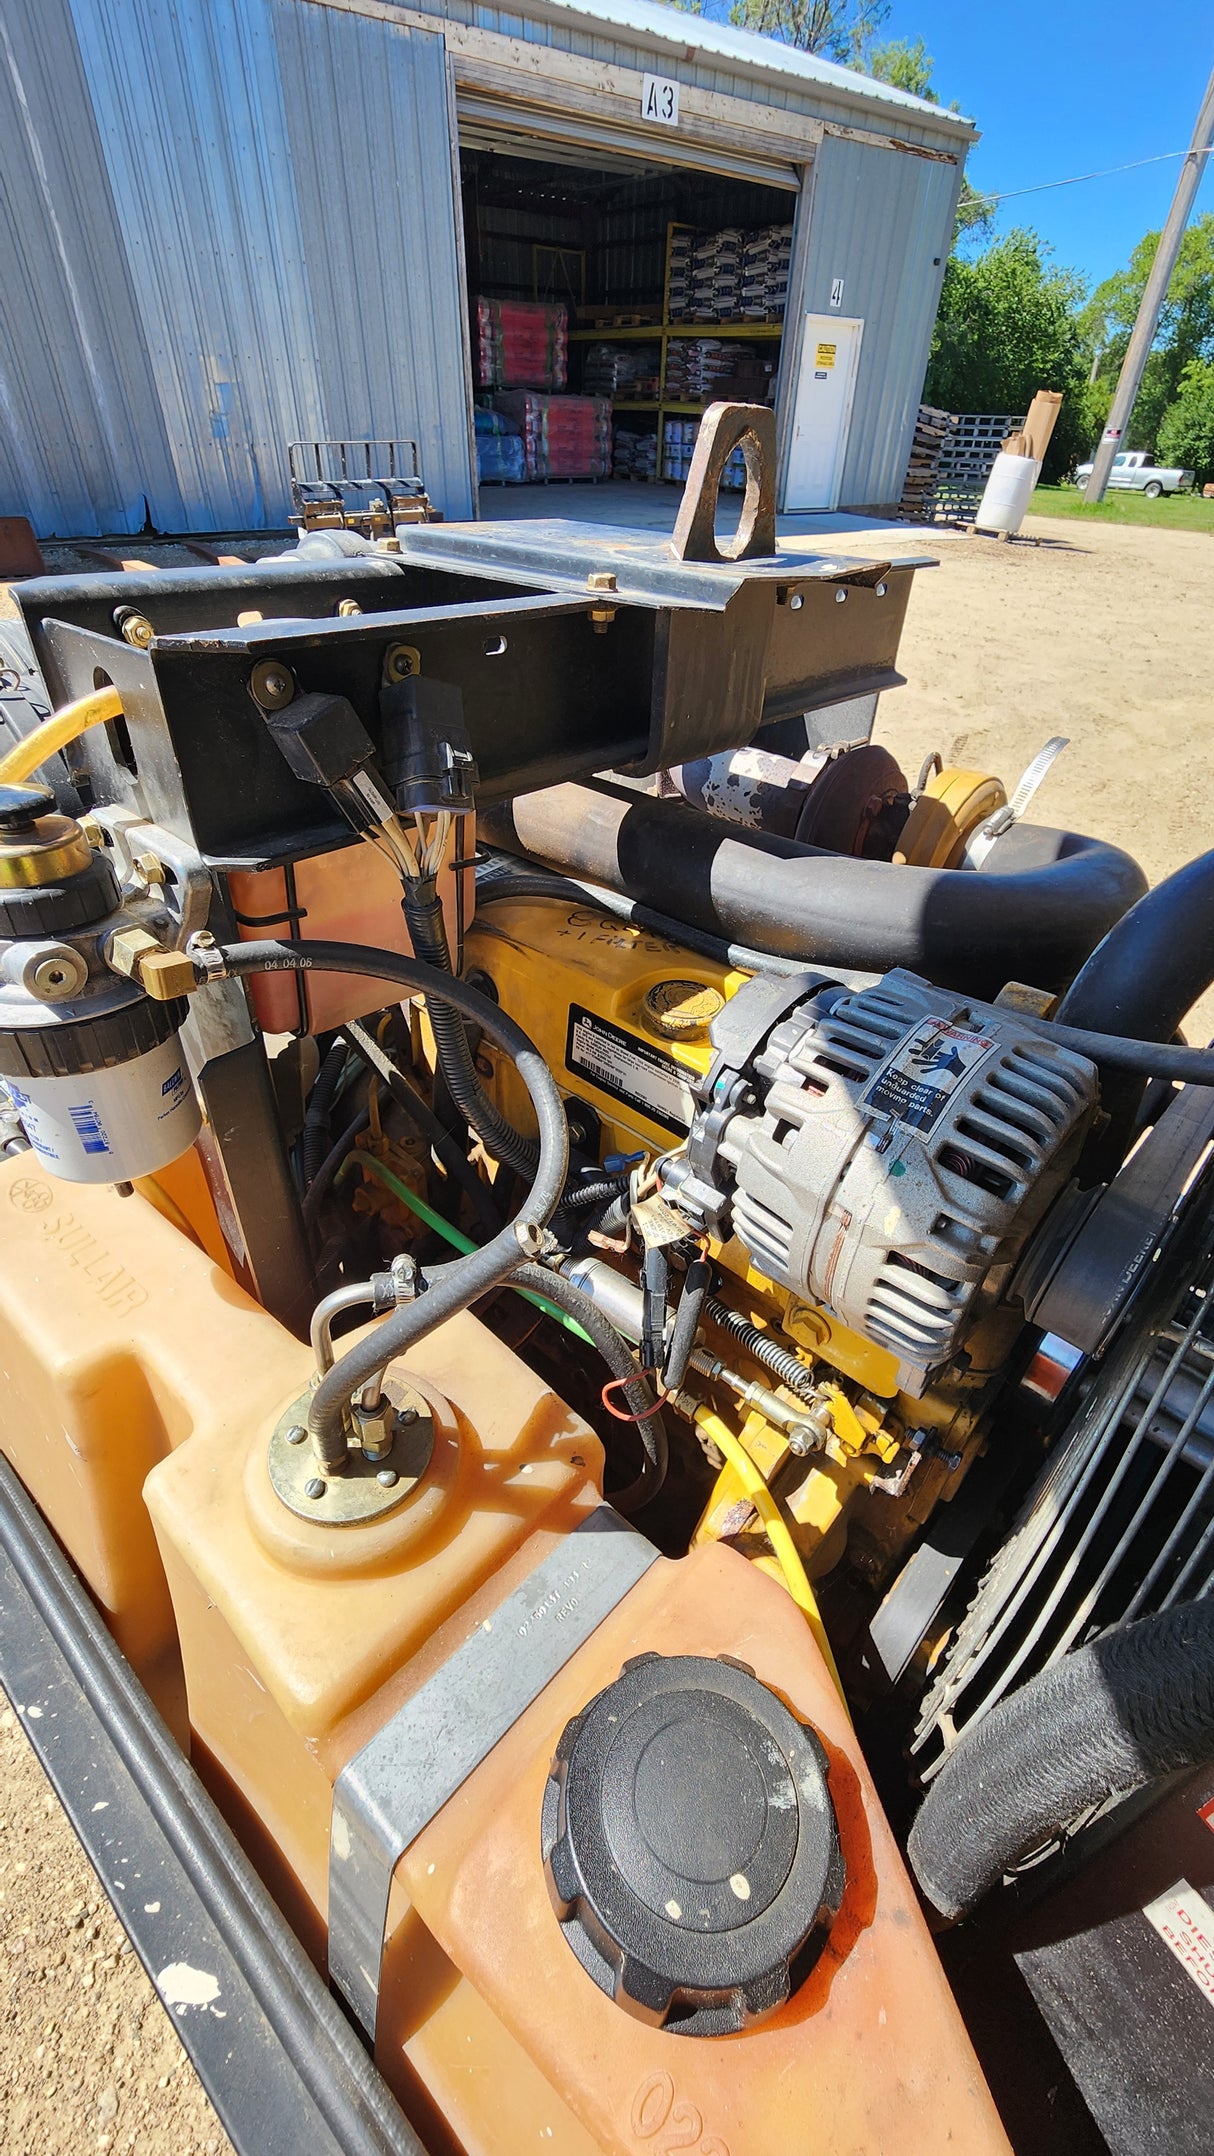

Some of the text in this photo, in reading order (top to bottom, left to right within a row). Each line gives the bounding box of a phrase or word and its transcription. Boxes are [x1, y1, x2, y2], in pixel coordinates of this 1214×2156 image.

[646, 81, 674, 119] A3
[831, 280, 842, 306] 4
[264, 961, 278, 971] 04
[283, 959, 296, 969] 04
[943, 1027, 989, 1049] WARNING
[881, 1077, 927, 1103] unguarded
[885, 1068, 947, 1102] Keep clear of
[875, 1085, 934, 1117] moving parts.
[42, 1213, 149, 1319] SULLAIR
